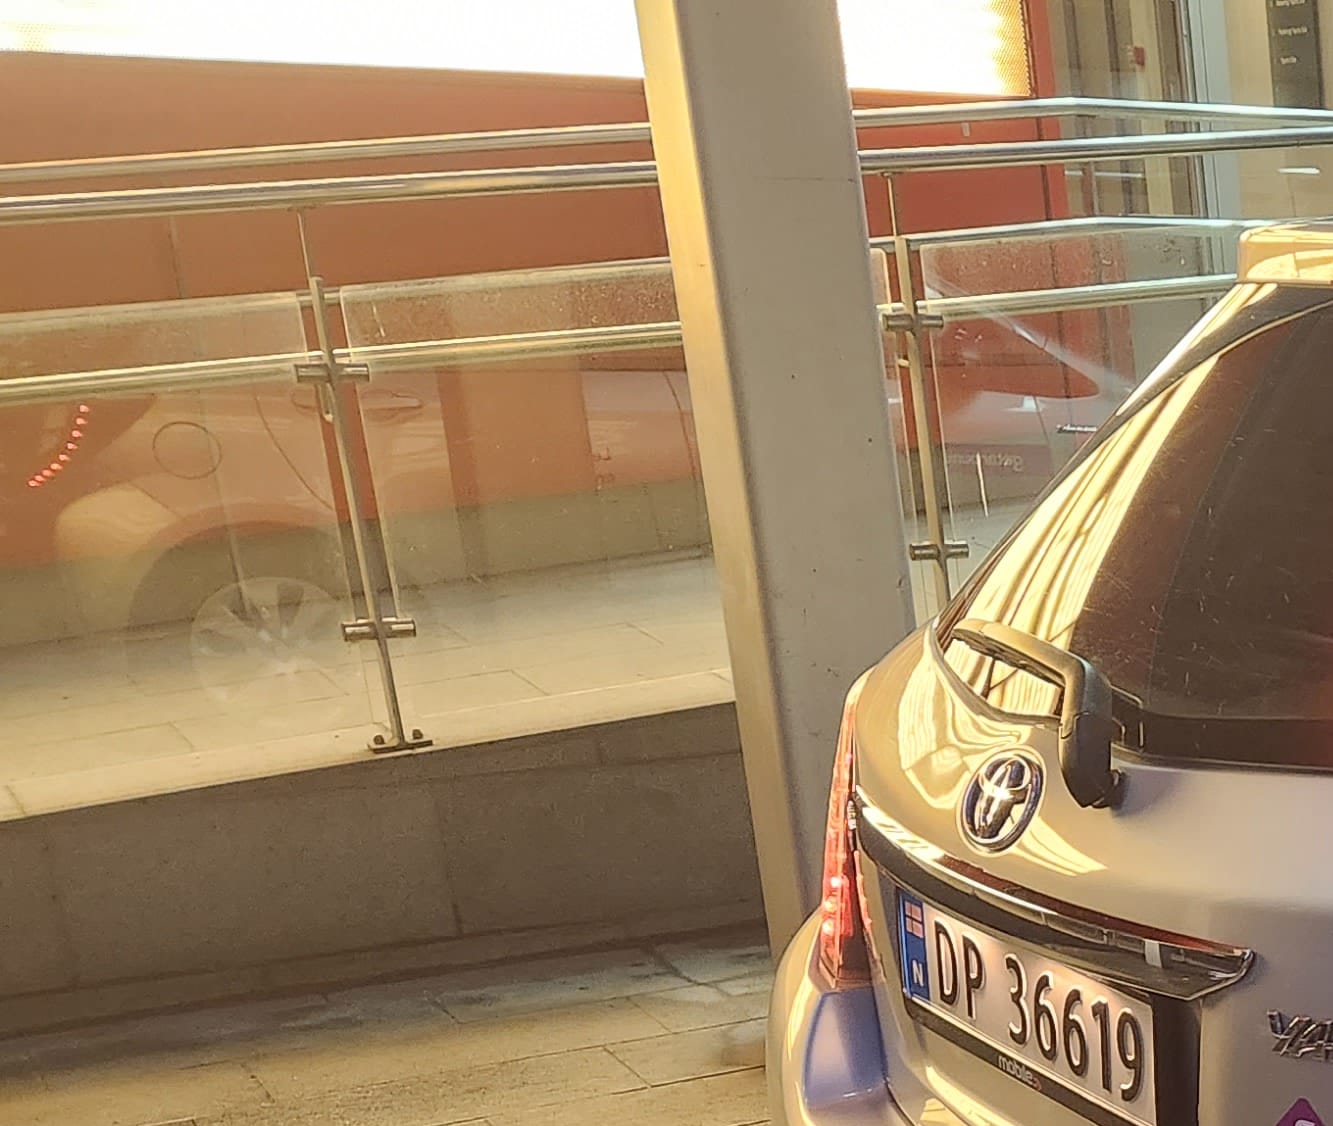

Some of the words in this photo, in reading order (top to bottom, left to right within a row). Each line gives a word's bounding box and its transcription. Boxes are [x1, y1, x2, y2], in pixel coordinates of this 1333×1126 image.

[912, 959, 925, 987] N
[933, 919, 986, 1021] DP
[1005, 953, 1144, 1103] 36619
